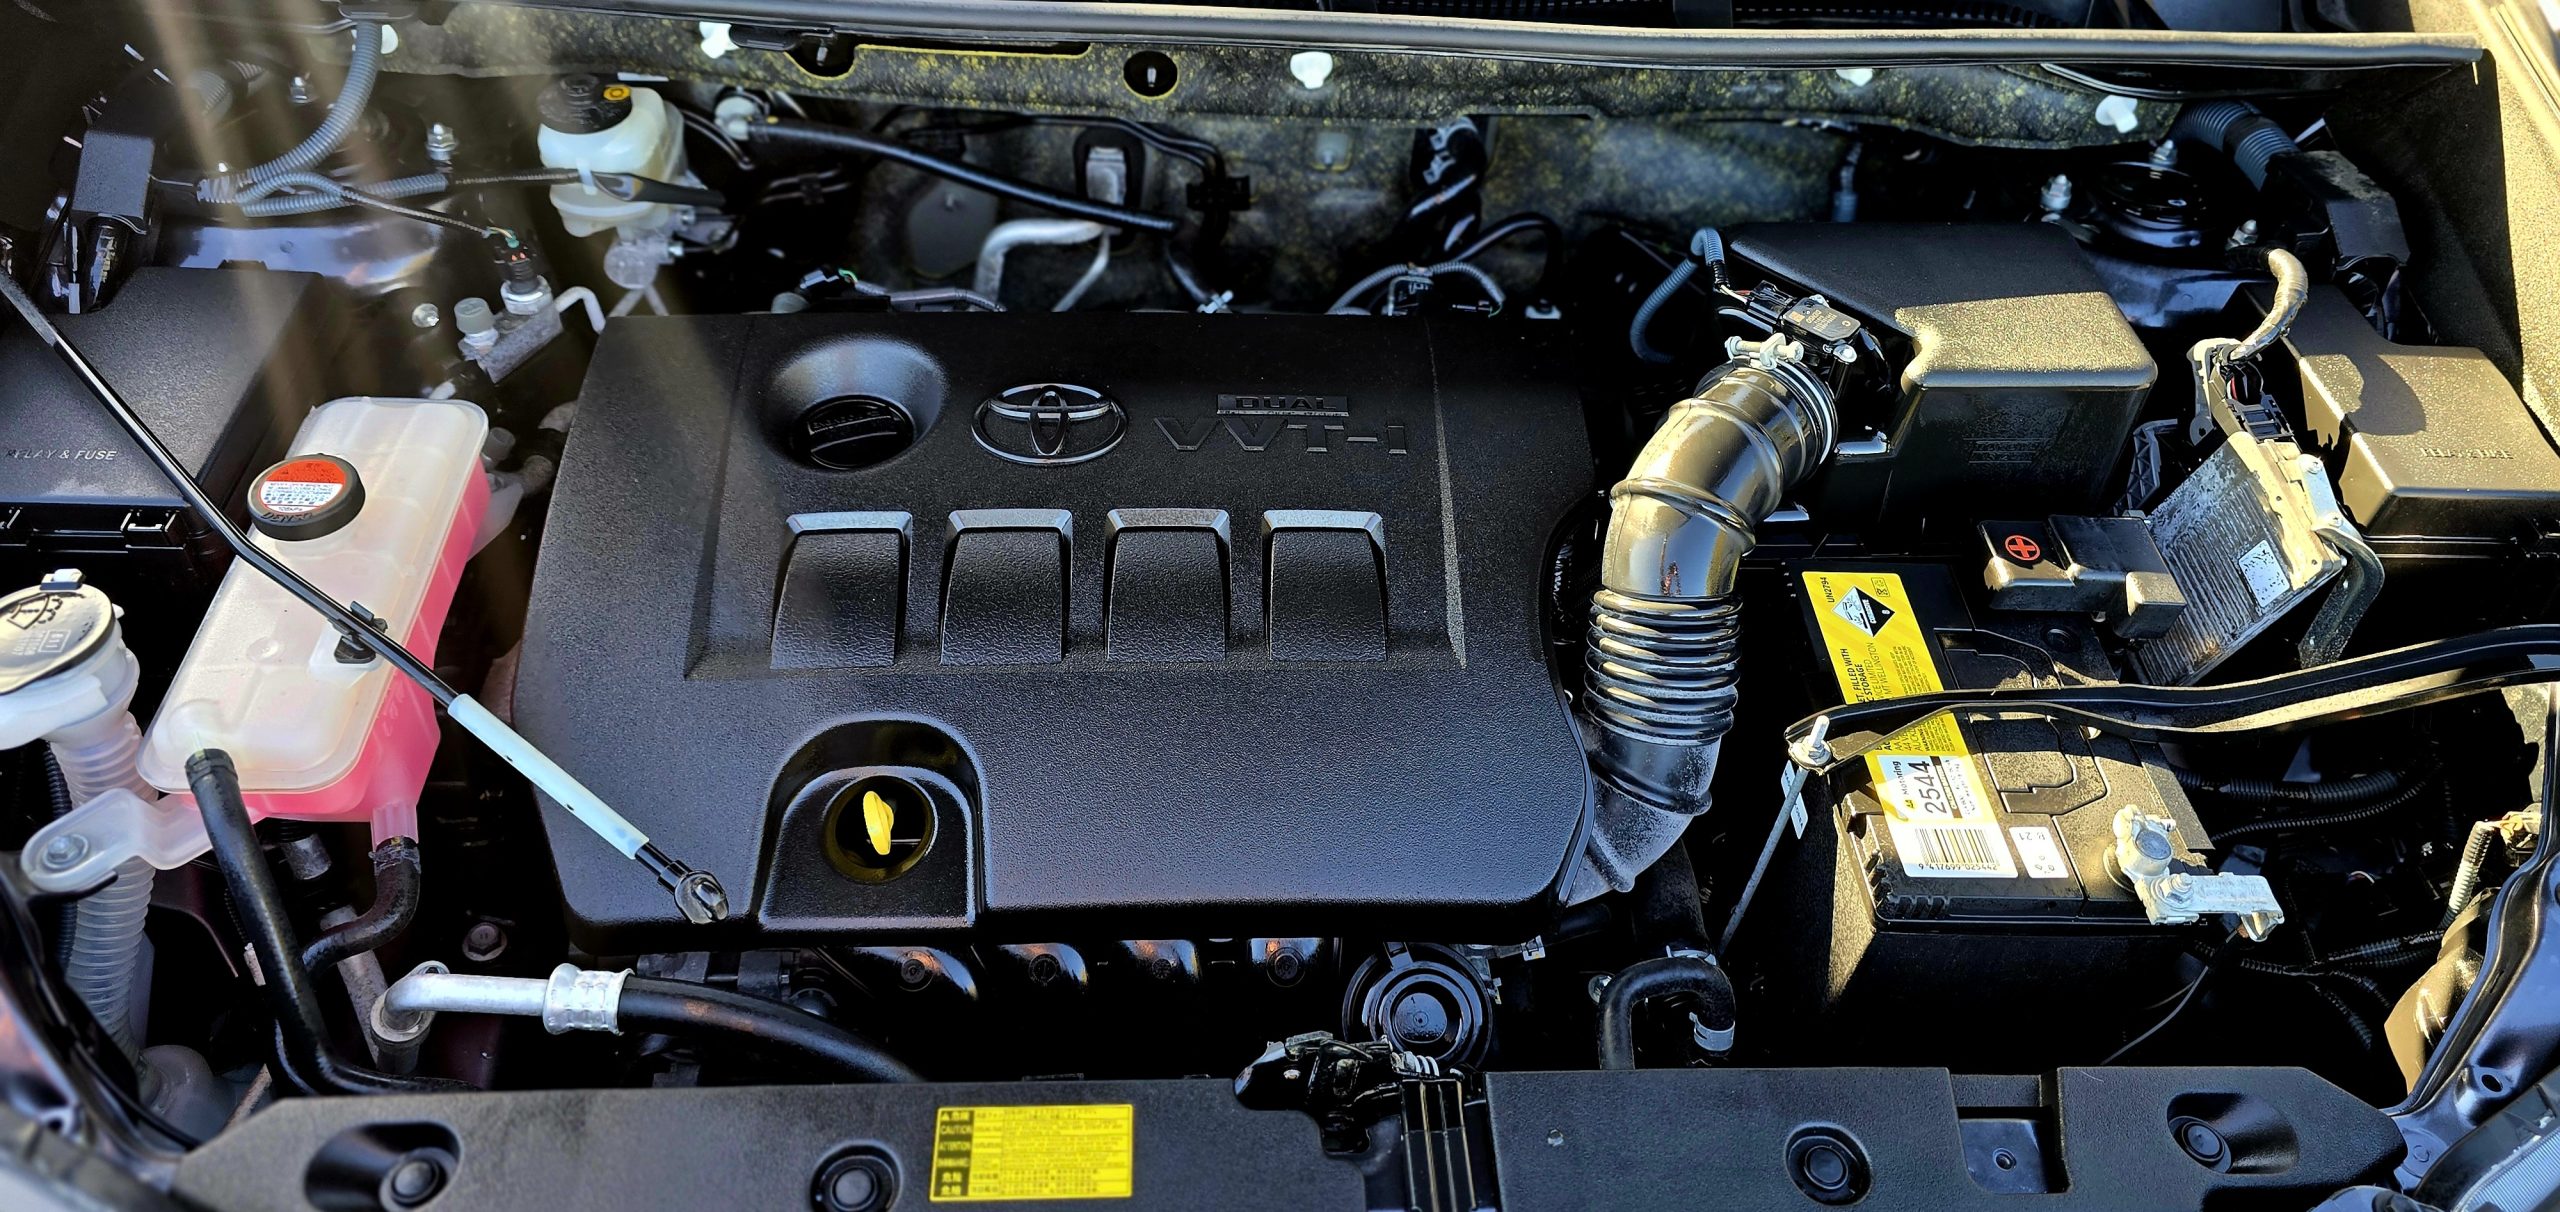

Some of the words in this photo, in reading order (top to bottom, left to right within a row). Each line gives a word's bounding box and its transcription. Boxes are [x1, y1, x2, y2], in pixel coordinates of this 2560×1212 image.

[1235, 396, 1337, 410] DUAL
[60, 449, 70, 459] &
[74, 450, 118, 461] FUSE
[1820, 576, 1835, 603] UN2794
[1840, 648, 1853, 667] WITH
[1866, 642, 1889, 684] WELLINGTON
[1847, 667, 1861, 691] FILLED
[1854, 663, 1872, 696] STORAGE
[1864, 659, 1879, 685] LIMITED
[1892, 761, 1908, 796] Motoring
[1908, 760, 1948, 814] 2544
[941, 1125, 973, 1136] CAUTION
